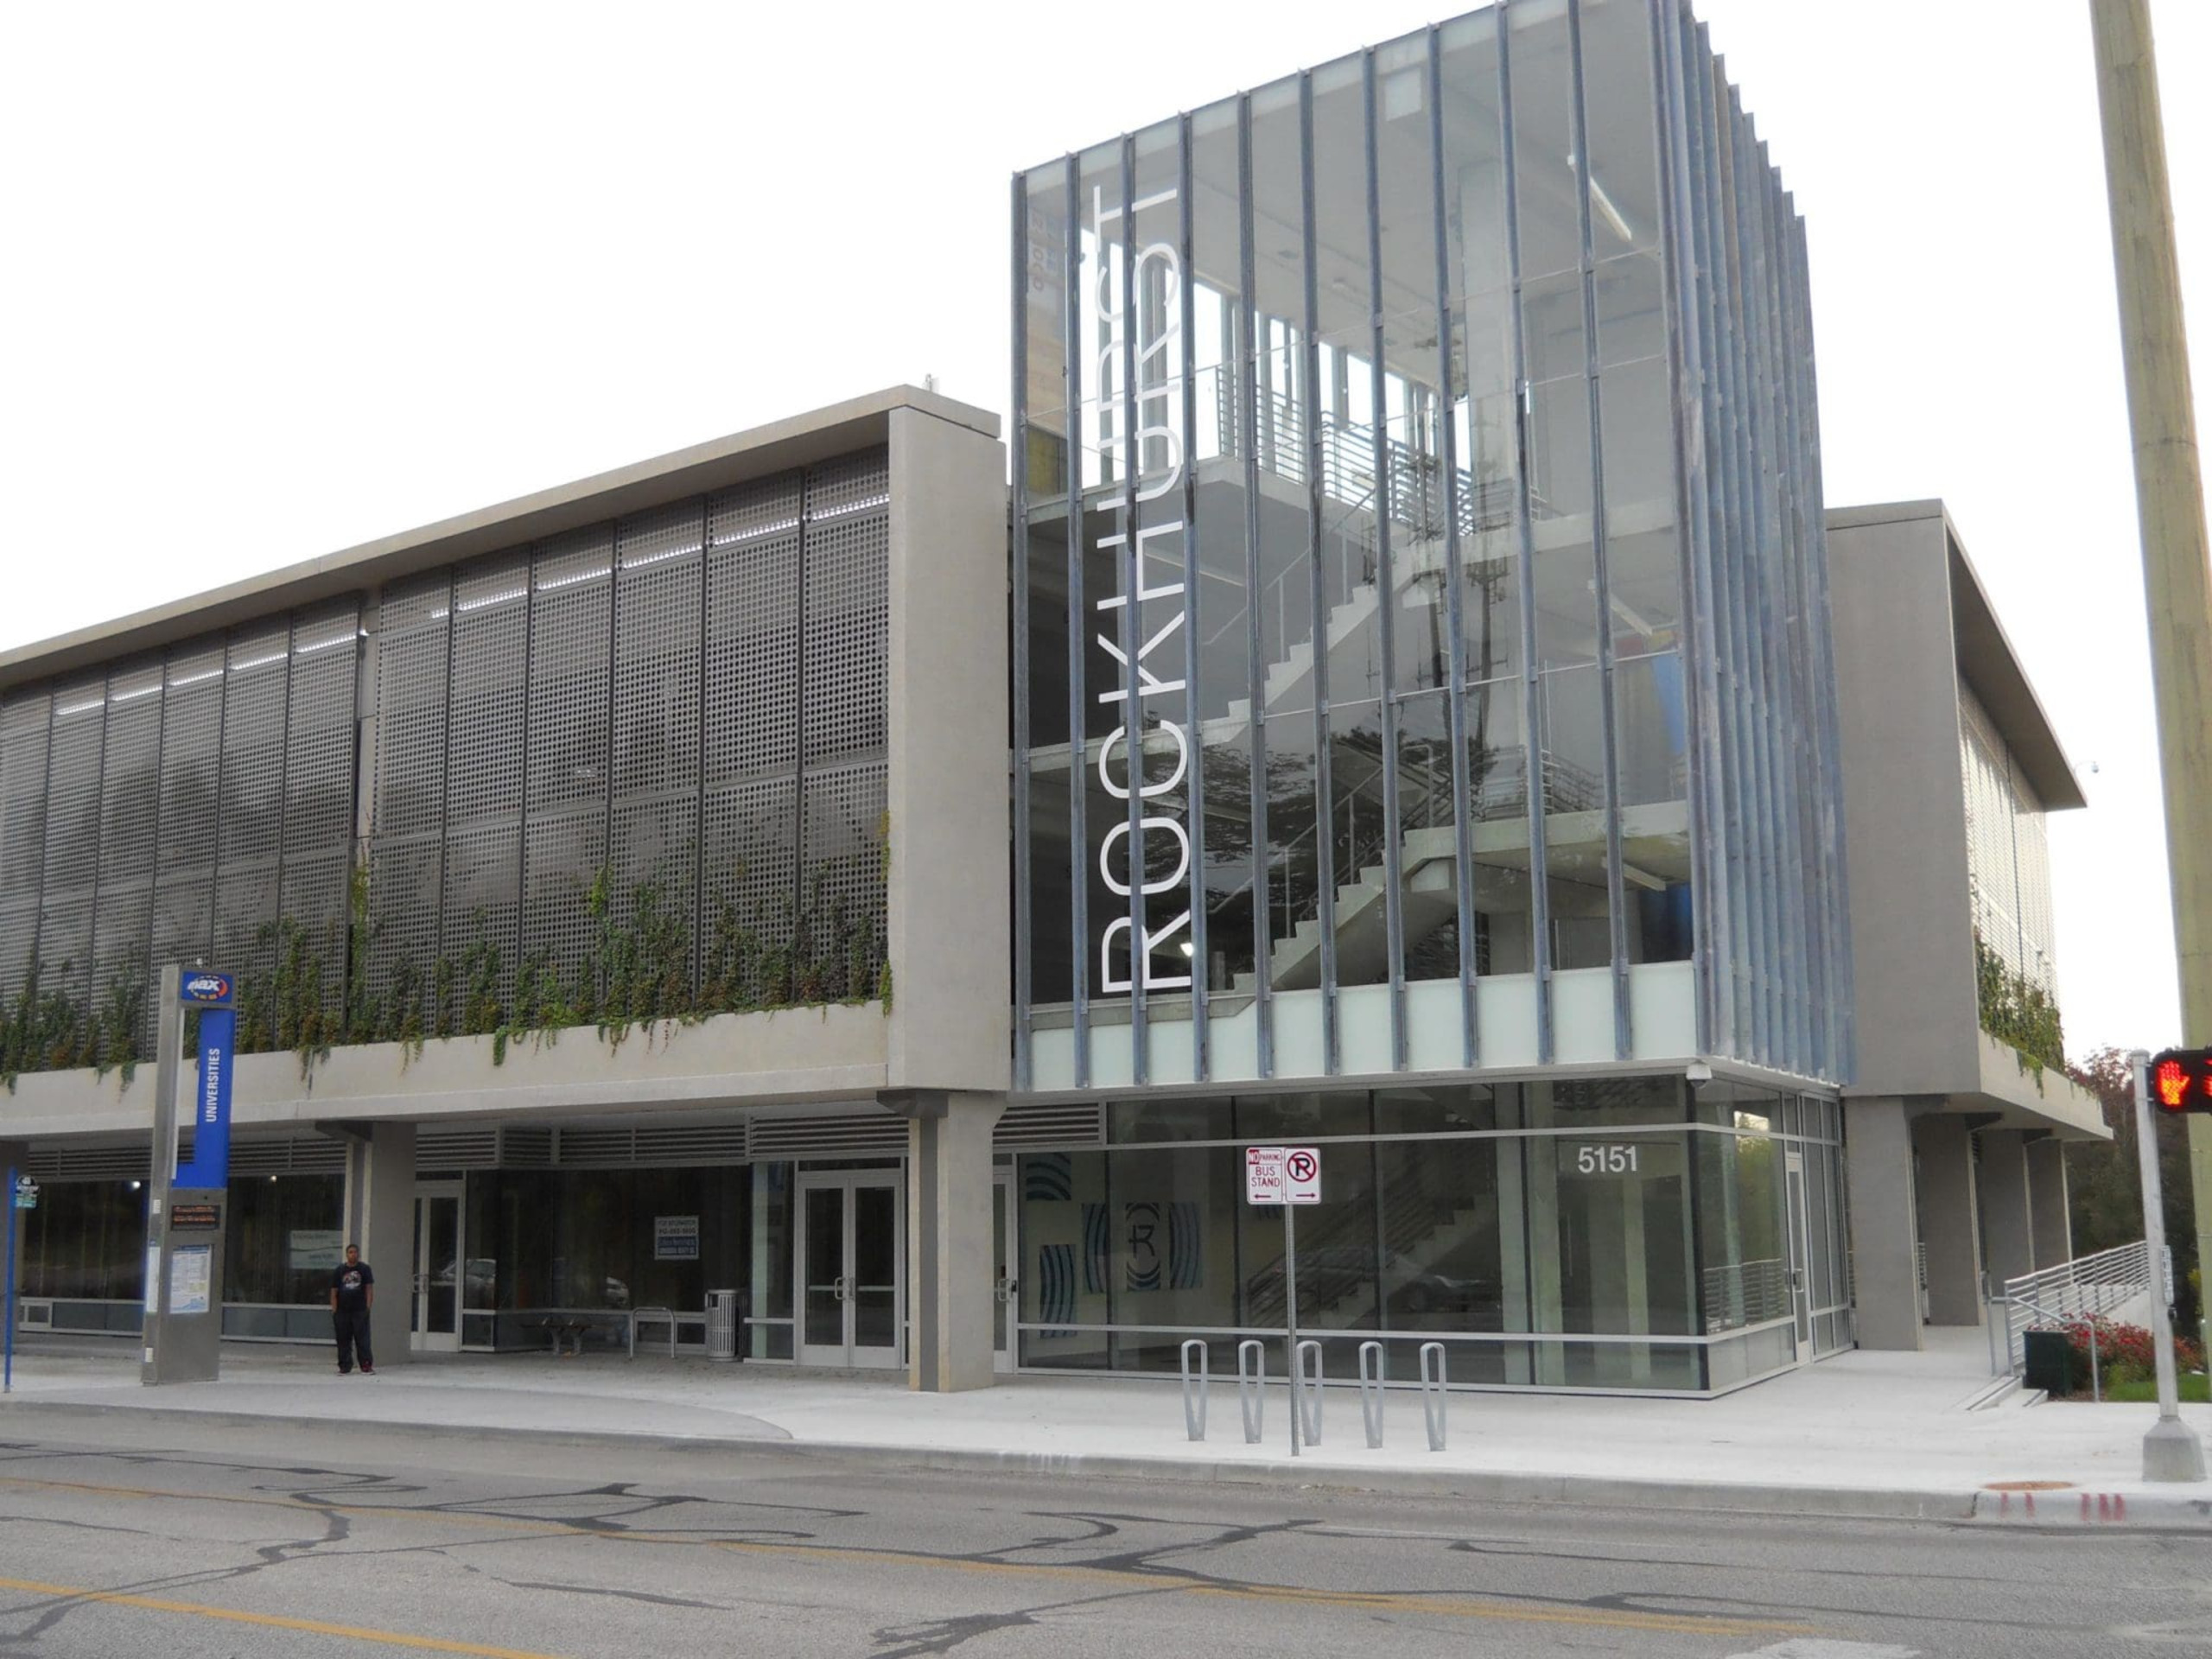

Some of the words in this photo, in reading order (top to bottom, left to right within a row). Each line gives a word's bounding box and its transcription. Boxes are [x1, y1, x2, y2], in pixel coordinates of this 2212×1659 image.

[1093, 184, 1192, 994] ROCKHURST
[205, 1047, 220, 1123] UNIVERSITIES
[1249, 1151, 1260, 1163] NO
[1259, 1153, 1281, 1161] PARKING
[1578, 1145, 1637, 1173] 5151
[1255, 1166, 1275, 1177] BUS
[1250, 1177, 1281, 1188] STAND
